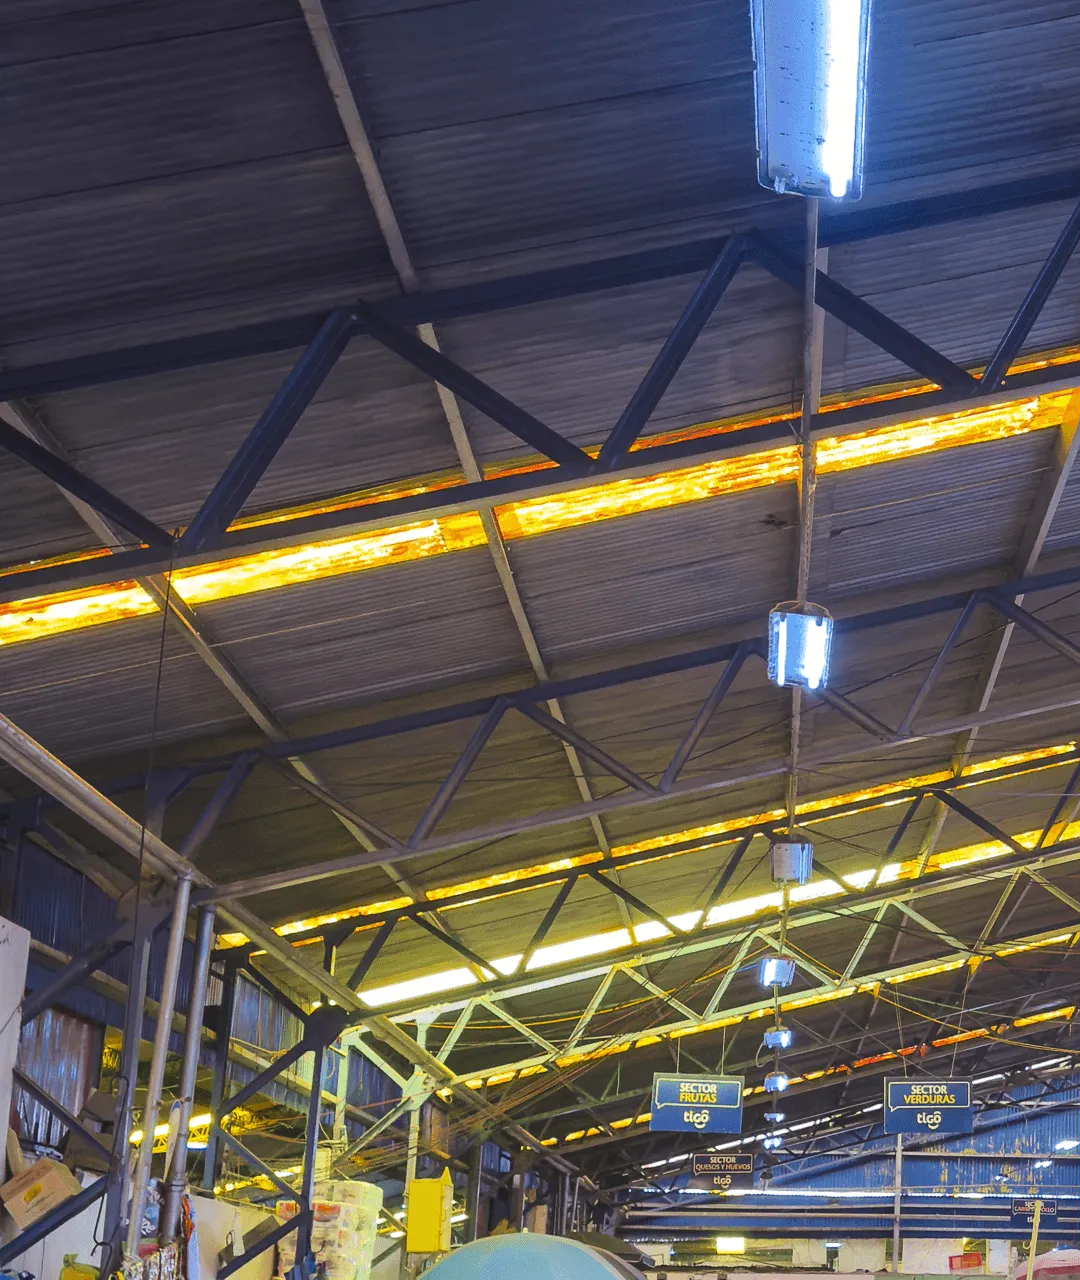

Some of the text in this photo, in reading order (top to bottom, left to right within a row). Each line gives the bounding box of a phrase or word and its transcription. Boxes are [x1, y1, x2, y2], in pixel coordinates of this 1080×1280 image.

[679, 1082, 718, 1094] SECTOR
[910, 1084, 948, 1095] SECTOR
[679, 1093, 717, 1103] FRUTAS
[903, 1094, 956, 1104] VERDURAS
[710, 1156, 736, 1164] SECTOR
